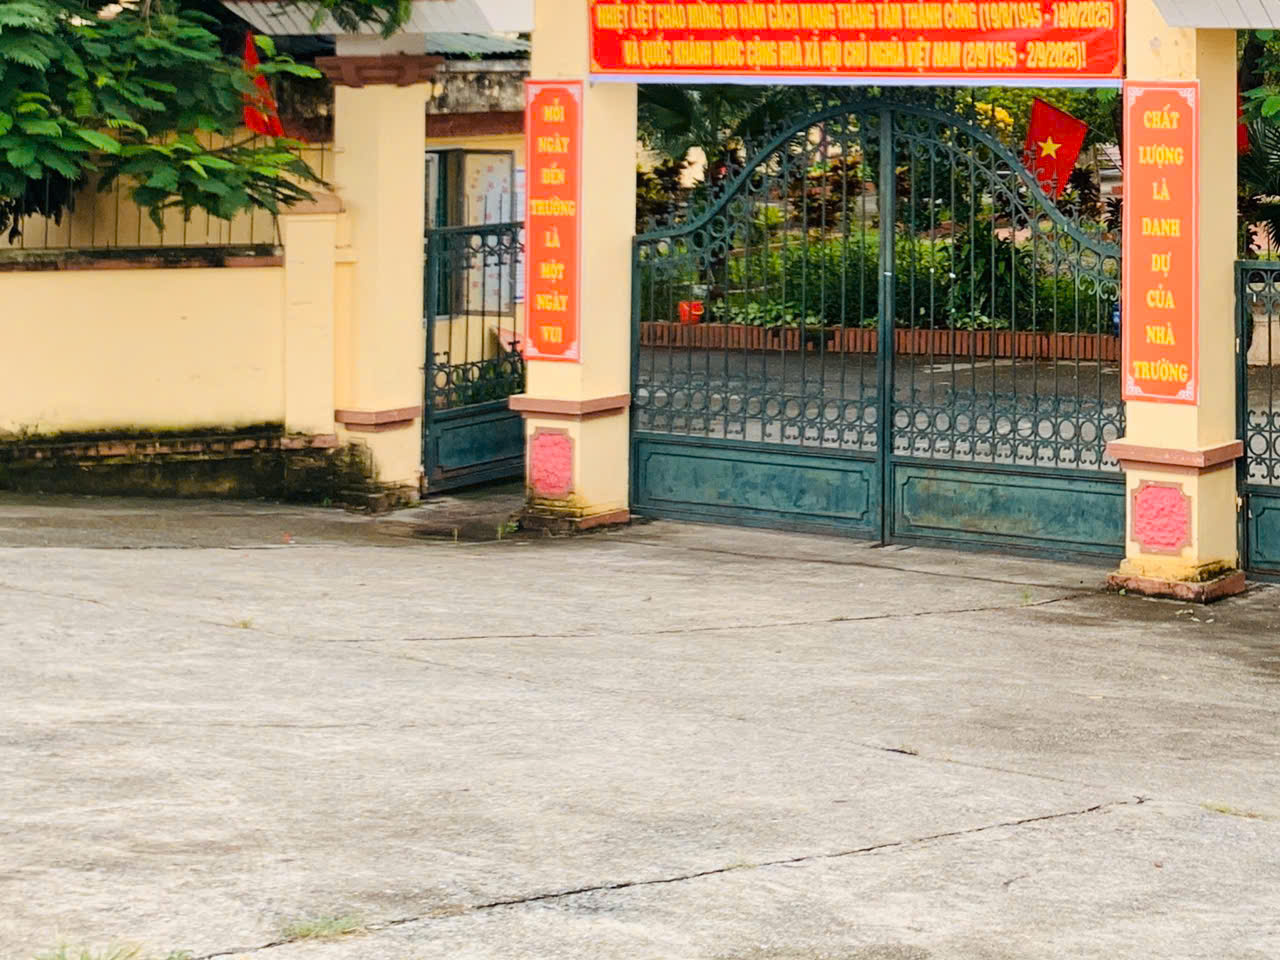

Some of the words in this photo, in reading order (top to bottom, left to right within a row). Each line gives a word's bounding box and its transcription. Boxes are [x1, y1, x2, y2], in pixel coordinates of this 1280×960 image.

[597, 0, 629, 34] NHIỆT
[630, 0, 653, 34] LIỆT
[656, 0, 686, 29] CHÀO
[768, 0, 799, 29] CÁCH
[1053, 1, 1115, 30] 19/8/2025)
[624, 36, 639, 65] VÀ
[641, 32, 672, 69] QUỐC
[906, 36, 930, 72] VIỆT
[932, 41, 961, 68] NAM
[1144, 104, 1180, 129] CHẤT
[538, 133, 570, 153] NGÀY
[1139, 145, 1184, 168] LƯỢNG
[541, 162, 566, 185] ĐẾN
[1152, 178, 1170, 200] LÀ
[530, 196, 576, 217] TRƯỜNG
[545, 226, 561, 248] LÀ
[1142, 217, 1181, 237] DANH
[540, 259, 565, 283] MỘT
[1152, 252, 1172, 277] DỰ
[536, 291, 568, 312] NGÀY
[1147, 284, 1175, 309] CỦA
[541, 326, 562, 343] VUI
[1146, 322, 1175, 346] NHÀ
[1133, 358, 1188, 382] TRƯỜNG
